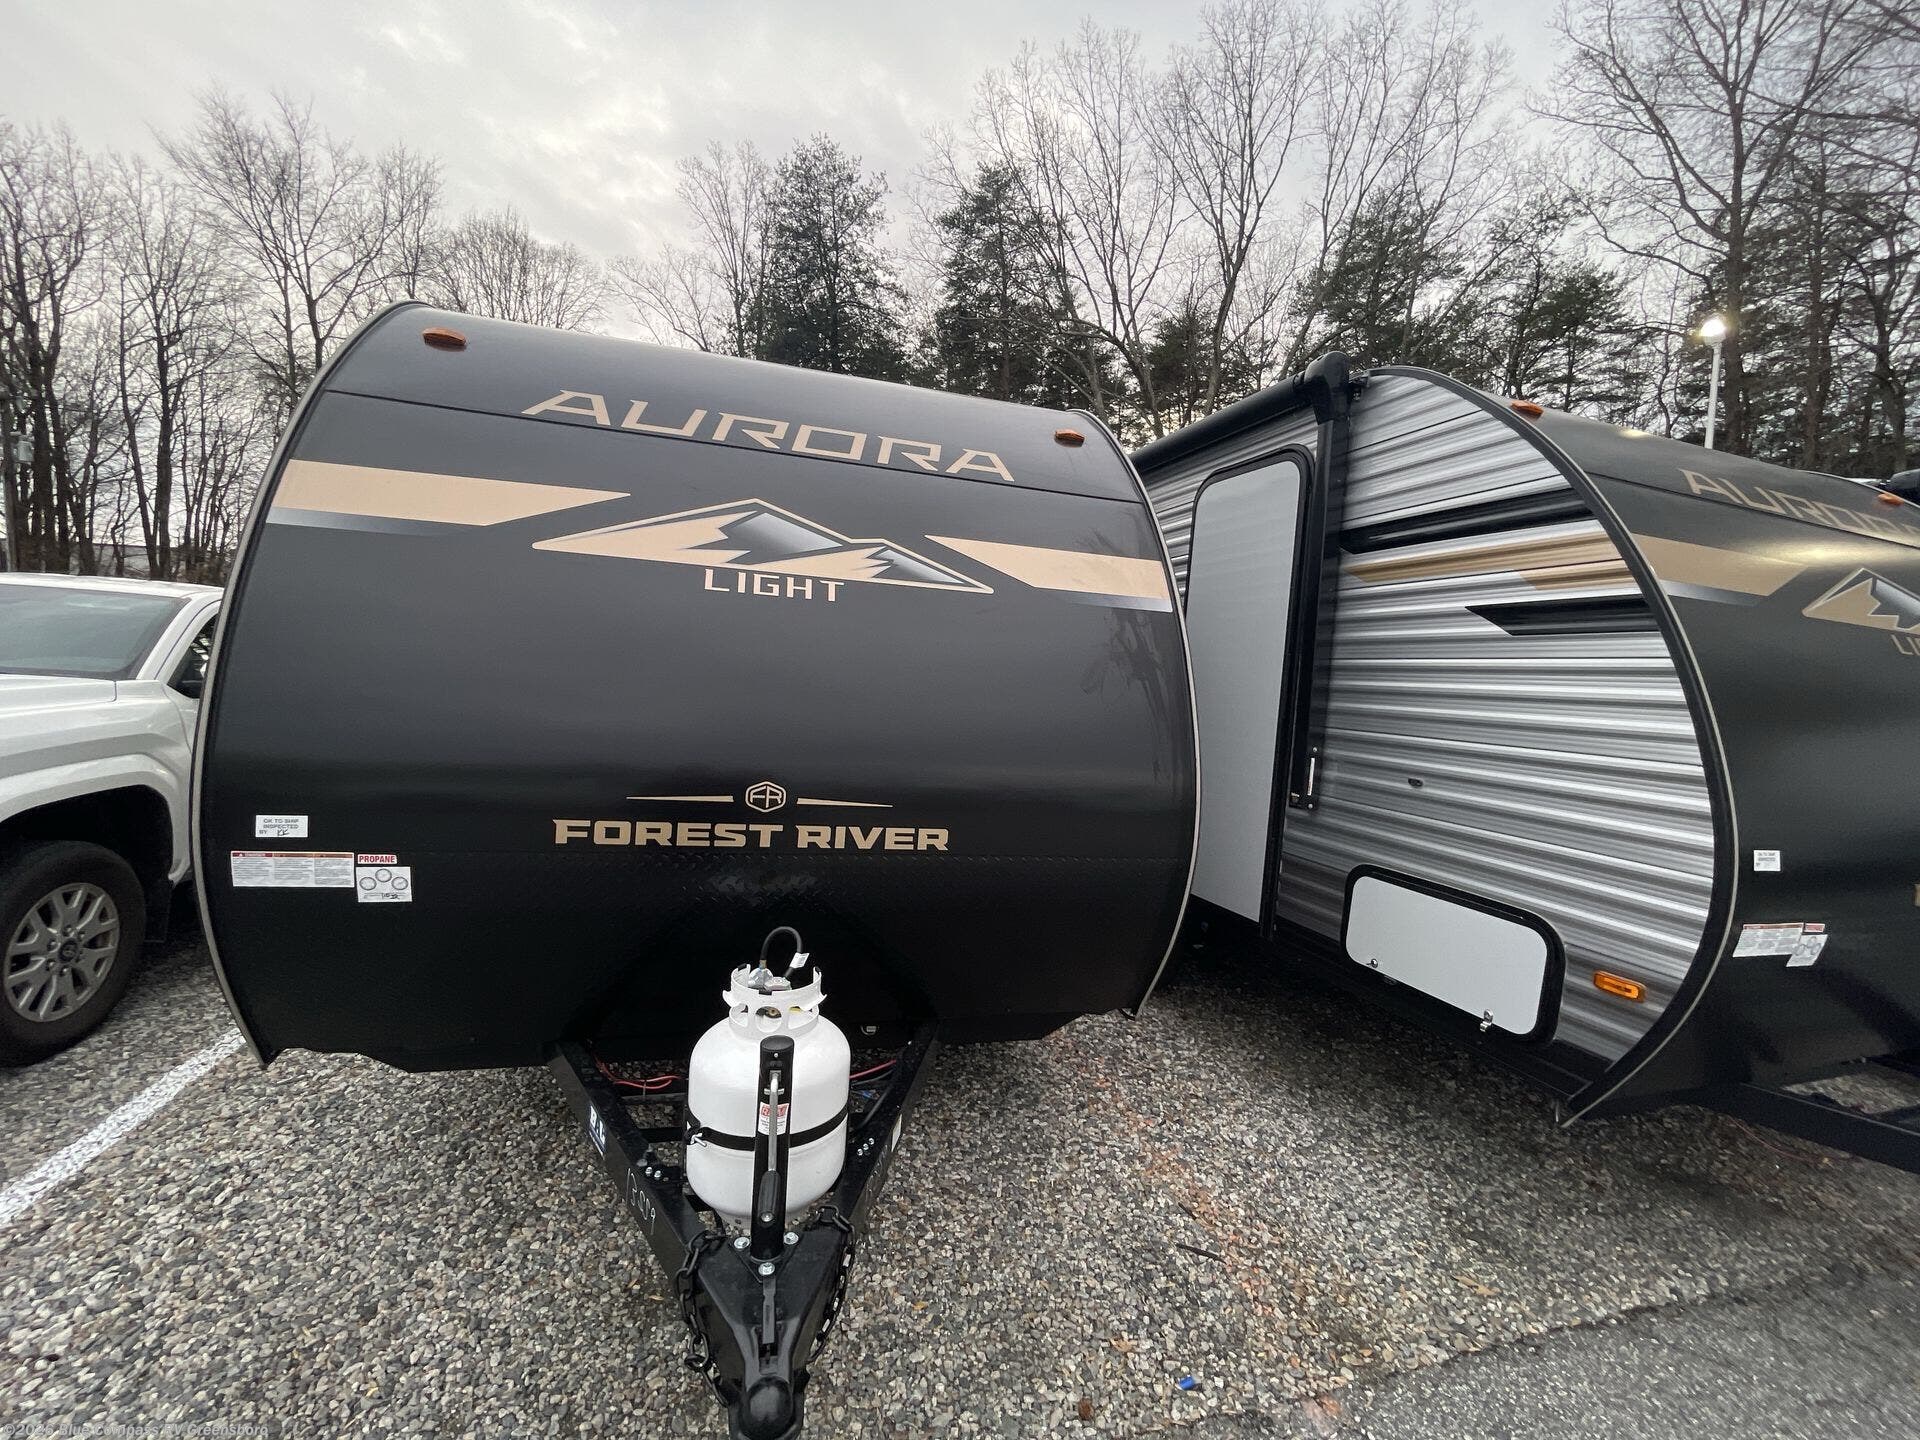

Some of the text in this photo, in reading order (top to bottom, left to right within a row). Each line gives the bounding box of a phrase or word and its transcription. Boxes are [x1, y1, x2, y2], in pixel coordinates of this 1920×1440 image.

[521, 389, 1016, 482] AURORA
[704, 568, 845, 602] LIGHT
[552, 819, 949, 852] FOREST RIVER
[358, 855, 396, 863] PROPANE
